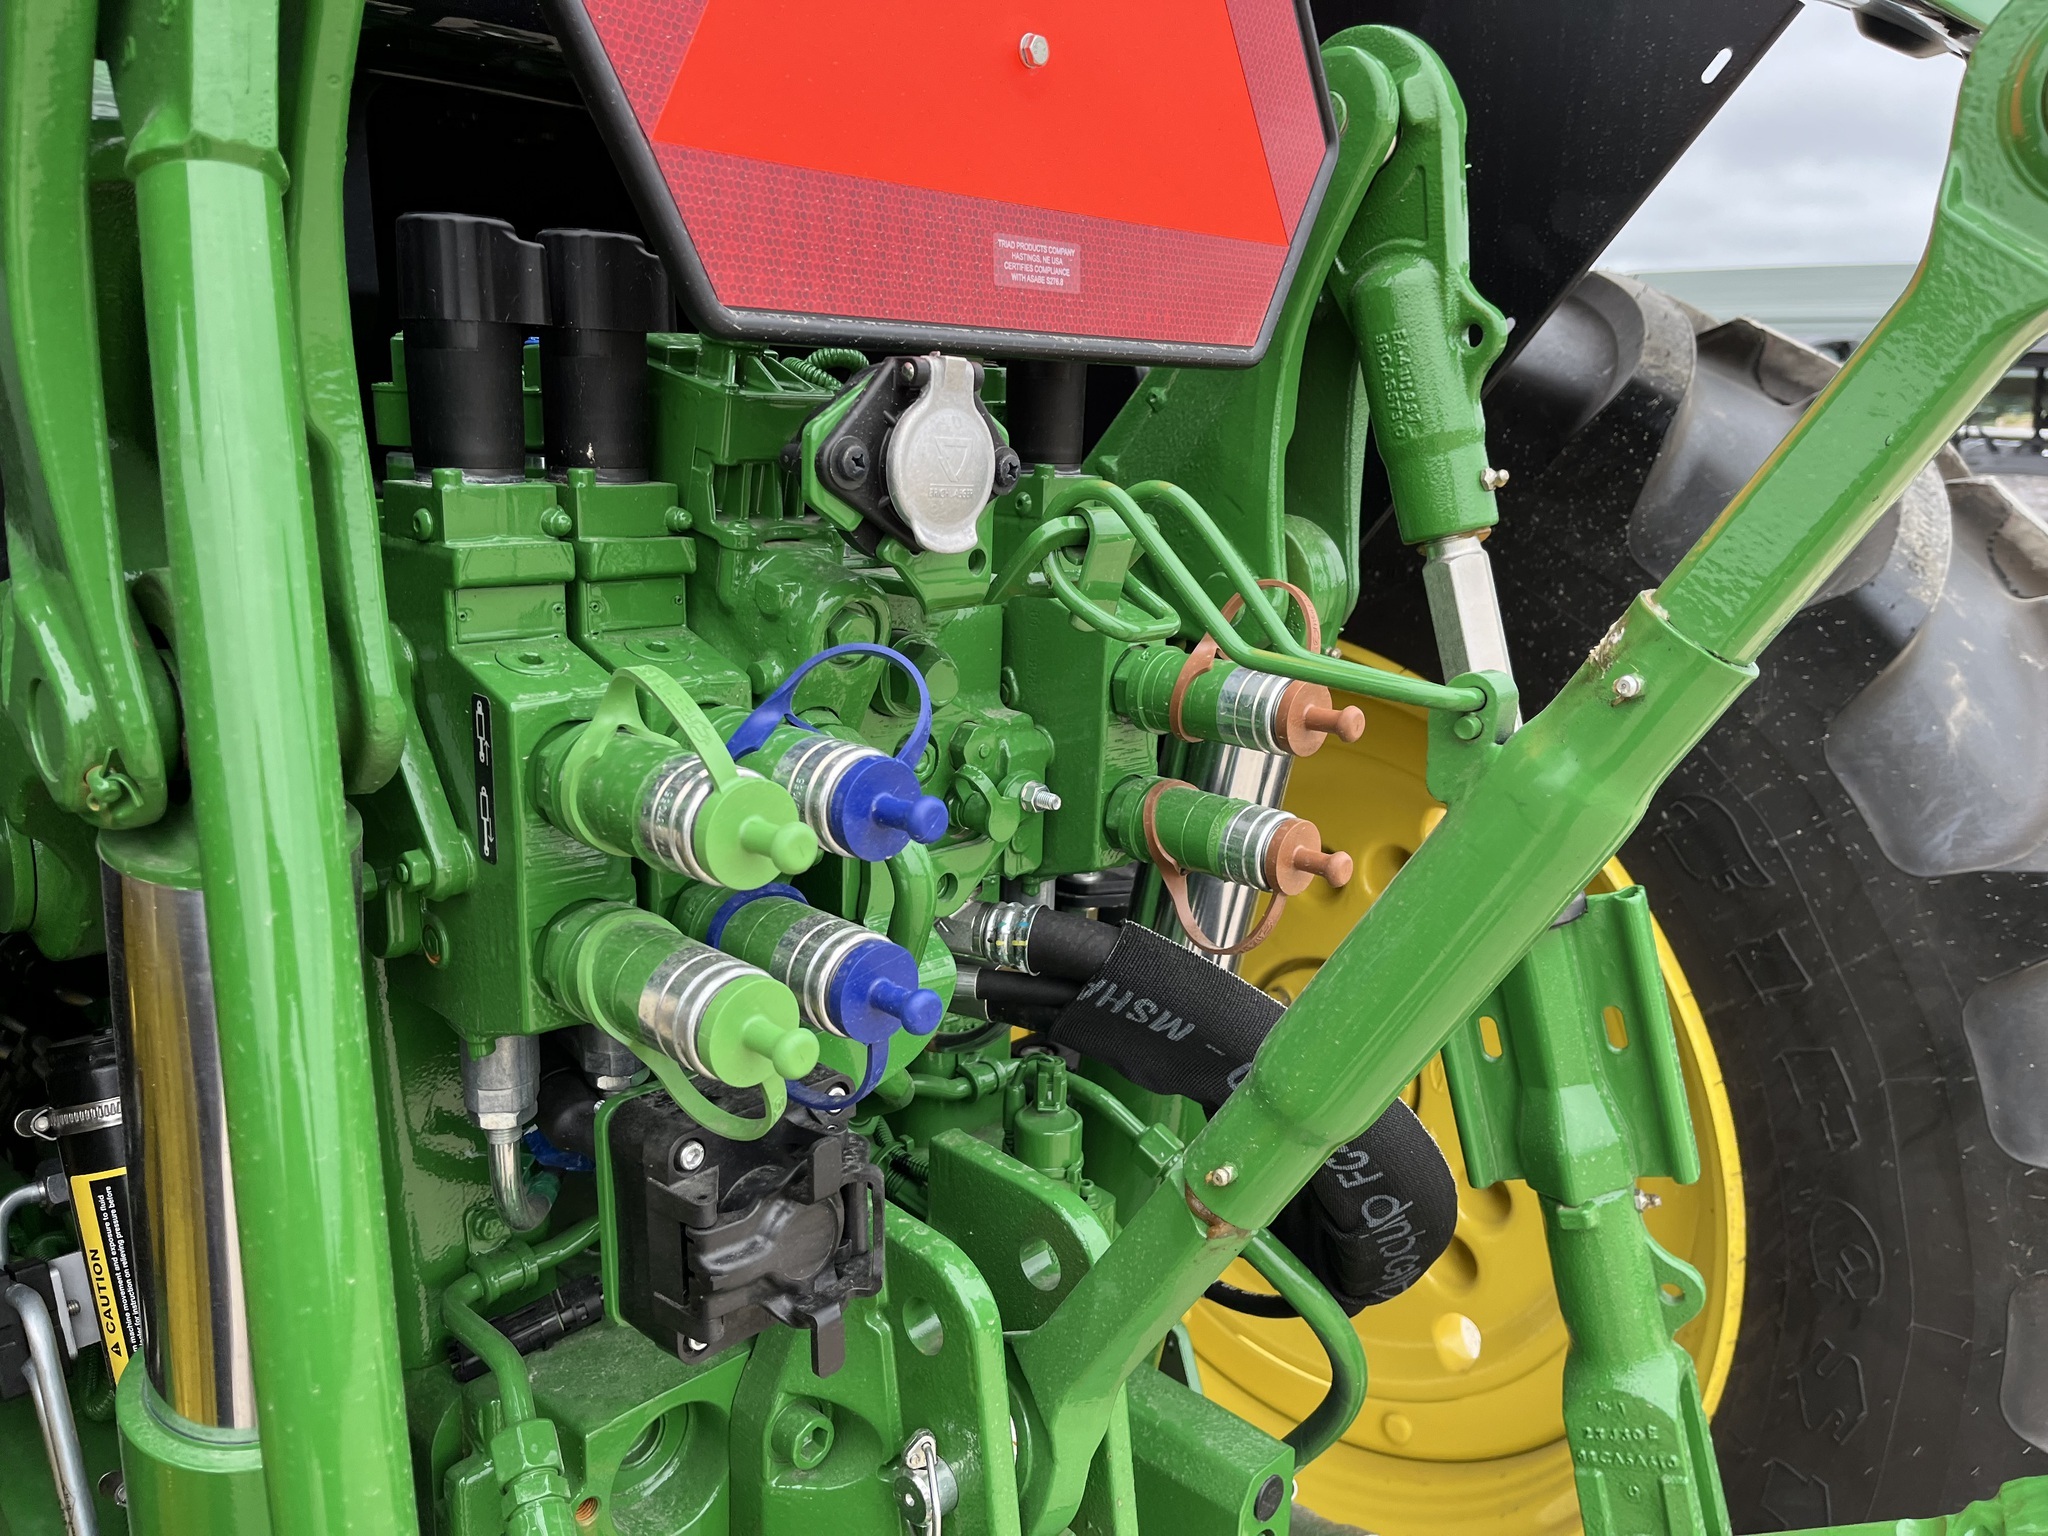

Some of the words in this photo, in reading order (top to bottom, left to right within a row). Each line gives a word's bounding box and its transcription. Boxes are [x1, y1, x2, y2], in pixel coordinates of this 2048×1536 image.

[997, 239, 1015, 249] TRIAD
[1016, 241, 1047, 254] PRODUCTS
[1048, 245, 1075, 257] COMPANY
[1043, 255, 1051, 264] NE
[1051, 256, 1063, 266] USA
[1004, 261, 1033, 272] CERTIFIES
[1034, 264, 1070, 277] COMPLIANCE
[1011, 273, 1026, 282] WITH
[1027, 275, 1045, 285] ASABE
[98, 1194, 106, 1211] fluid
[105, 1185, 114, 1208] before
[110, 1208, 122, 1238] pressure
[105, 1221, 117, 1255] exposure
[116, 1239, 129, 1268] relieving
[90, 1249, 114, 1334] CAUTION
[116, 1271, 129, 1310] movement
[125, 1278, 138, 1315] instruction
[125, 1311, 136, 1343] machine
